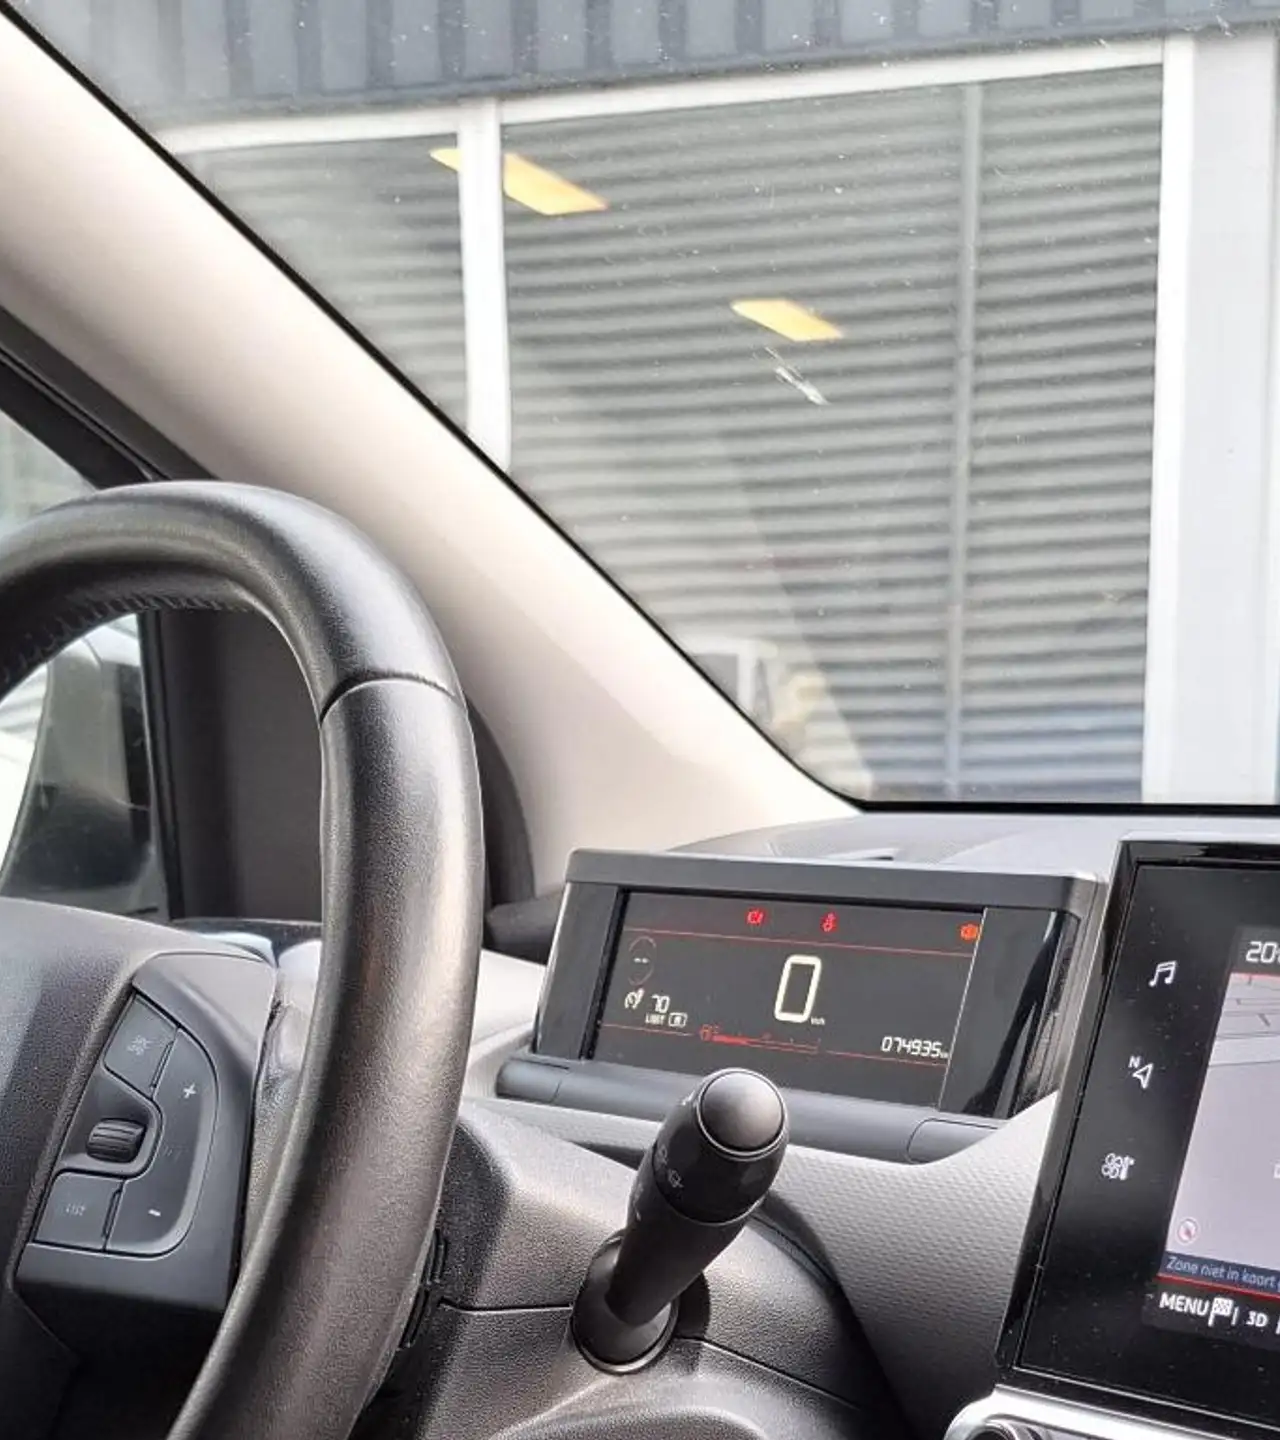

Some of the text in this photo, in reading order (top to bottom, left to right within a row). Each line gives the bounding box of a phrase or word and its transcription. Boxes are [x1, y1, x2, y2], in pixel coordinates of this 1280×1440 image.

[774, 954, 822, 1023] 0
[651, 994, 671, 1014] 70
[880, 1035, 943, 1058] 074935
[1167, 1256, 1198, 1274] Zone
[1200, 1265, 1224, 1280] niet
[1226, 1268, 1240, 1281] in
[1158, 1291, 1269, 1328] MENU 3D
